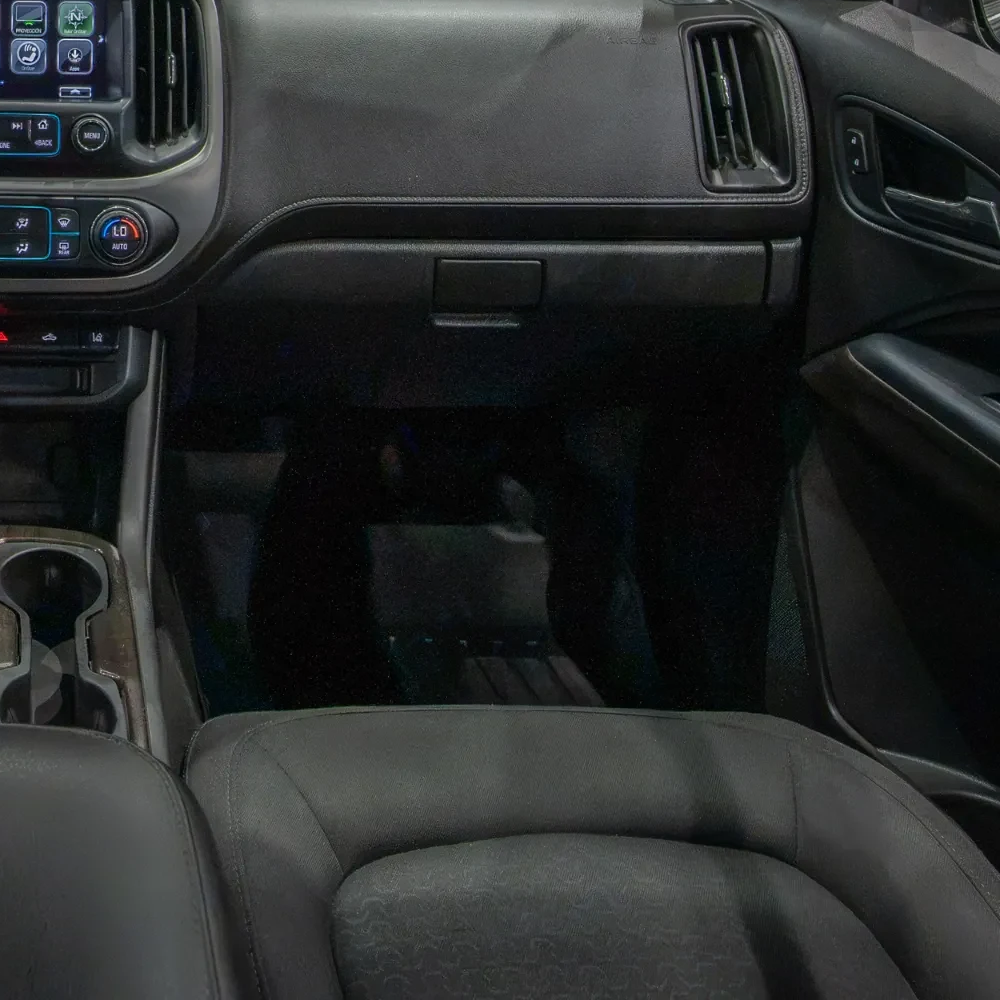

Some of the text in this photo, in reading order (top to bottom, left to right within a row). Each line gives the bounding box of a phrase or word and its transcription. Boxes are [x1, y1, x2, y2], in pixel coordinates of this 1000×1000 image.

[84, 131, 101, 140] MENU
[38, 139, 53, 147] BACK
[113, 226, 127, 237] LO
[112, 243, 128, 251] AUTO
